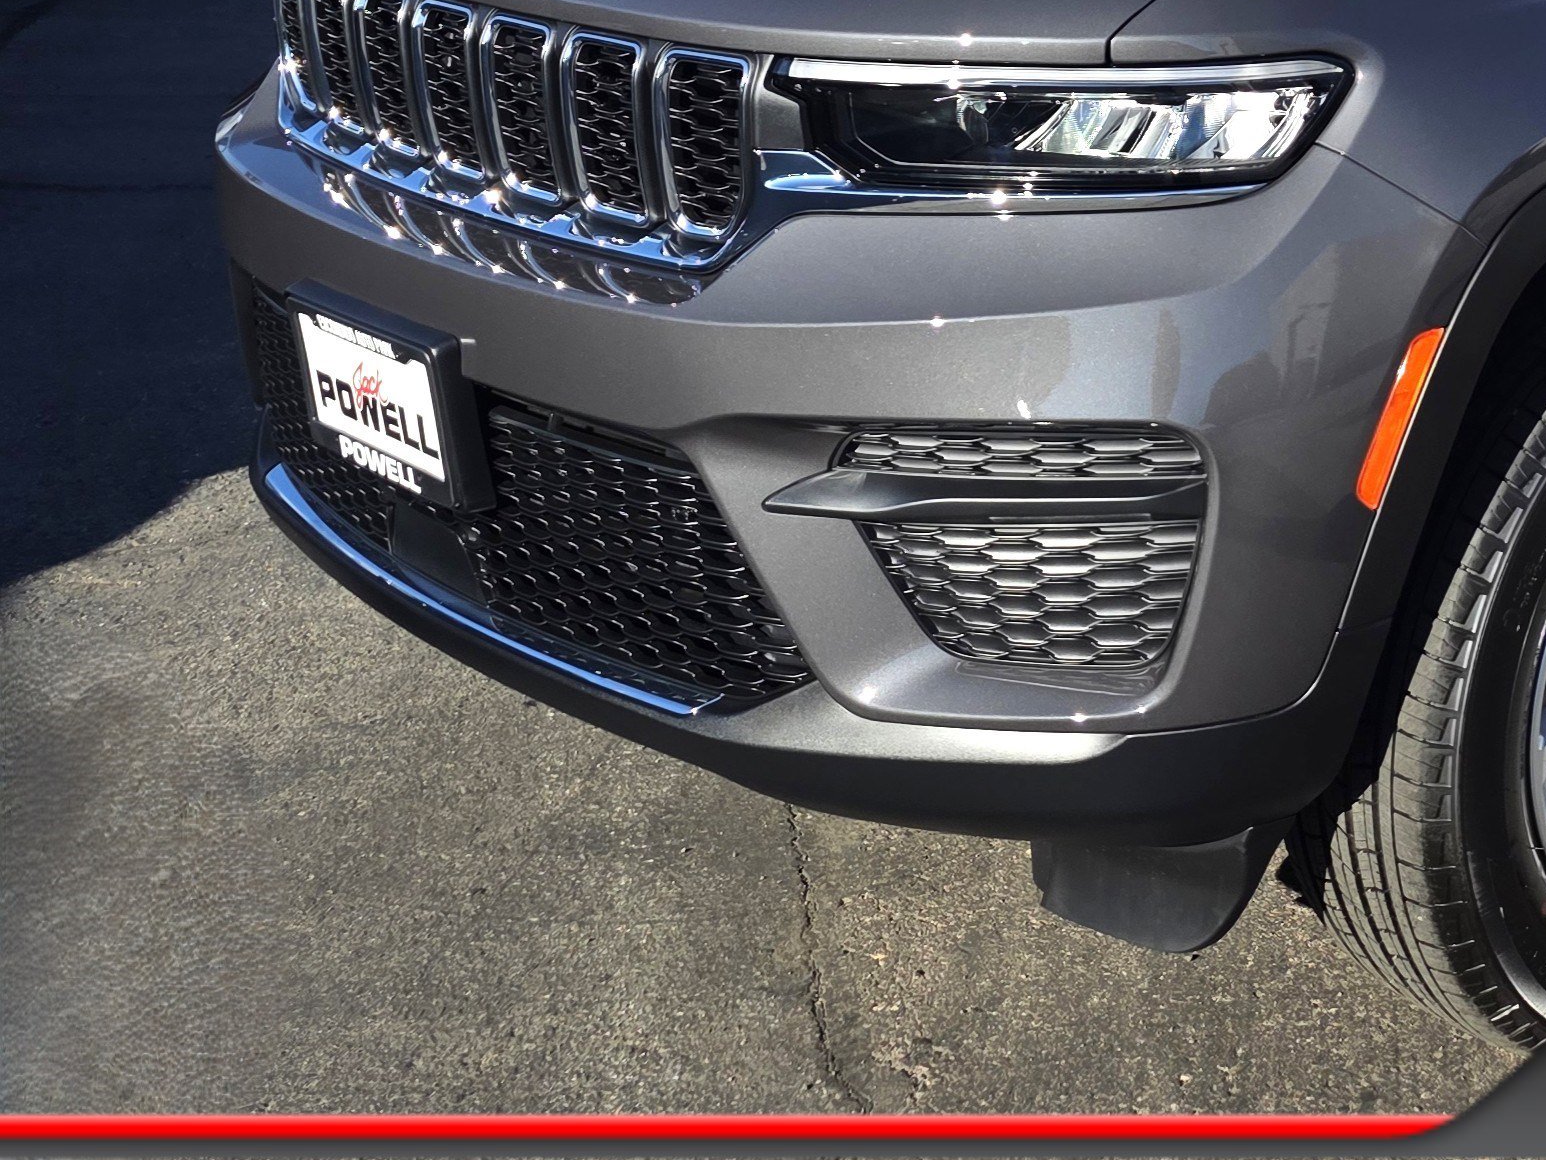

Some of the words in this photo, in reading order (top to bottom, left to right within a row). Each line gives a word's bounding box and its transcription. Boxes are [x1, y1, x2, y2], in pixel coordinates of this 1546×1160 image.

[316, 369, 441, 461] POWELL
[352, 361, 389, 410] Jack
[338, 434, 423, 496] POWELL
